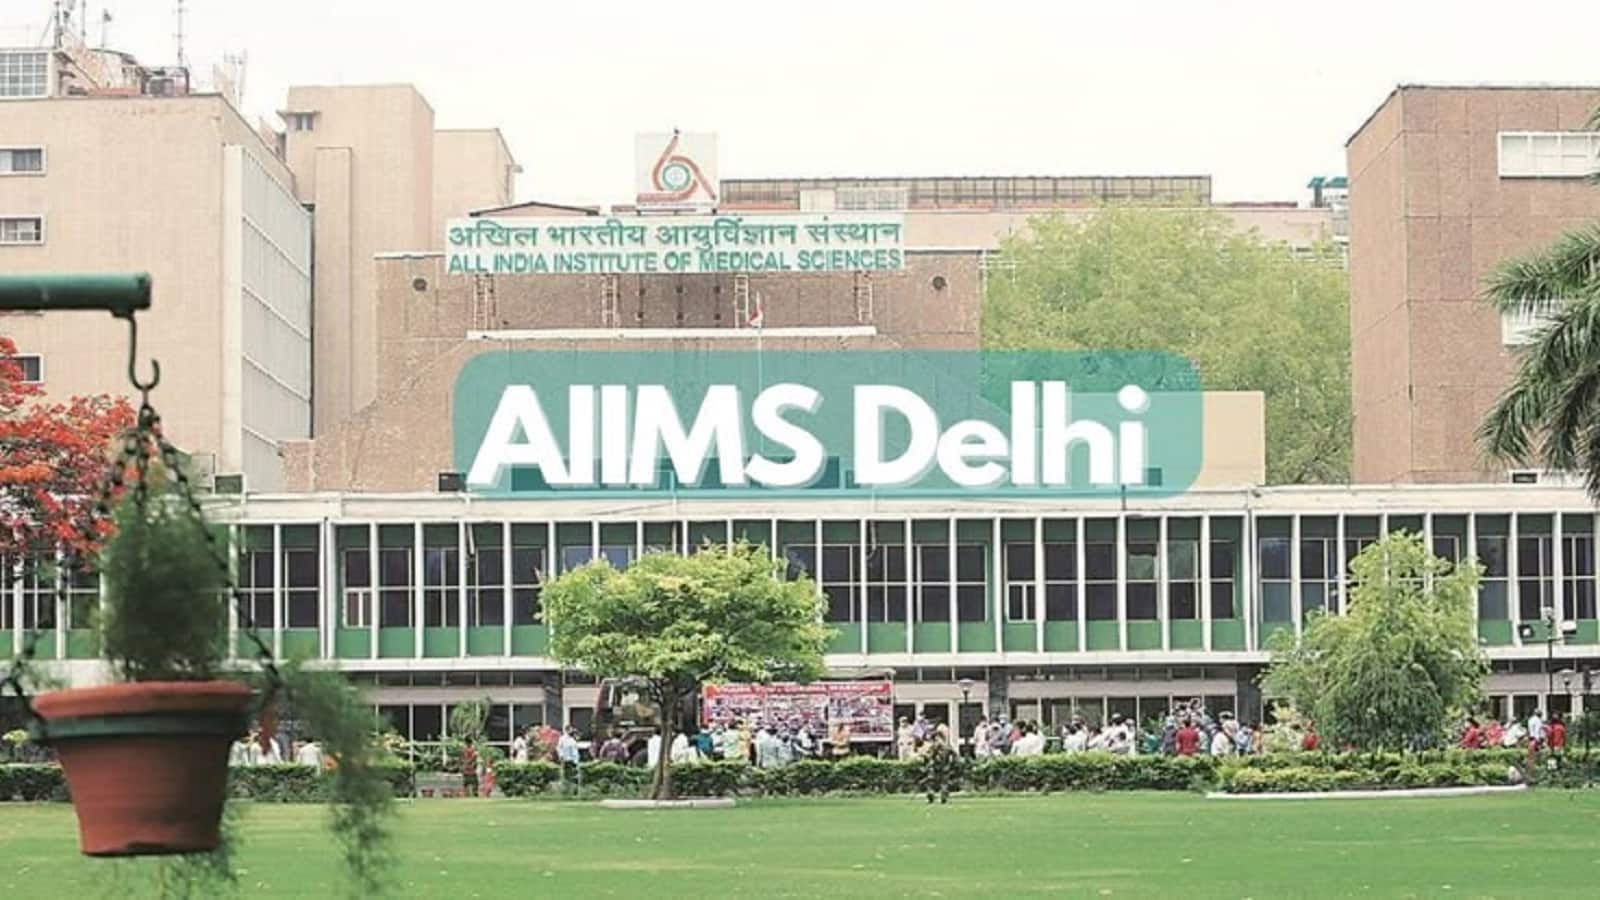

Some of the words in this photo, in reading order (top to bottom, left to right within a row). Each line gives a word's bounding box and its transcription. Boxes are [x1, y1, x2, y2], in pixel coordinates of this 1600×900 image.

[449, 219, 538, 247] अखिल
[547, 218, 647, 247] भारतीय
[805, 216, 902, 245] संस्थान
[449, 252, 488, 273] ALL
[494, 252, 549, 273] INDIA
[554, 252, 658, 273] INSTITUTE
[664, 250, 692, 272] OF
[699, 249, 791, 271] MEDICAL
[797, 249, 900, 270] SCIENCES
